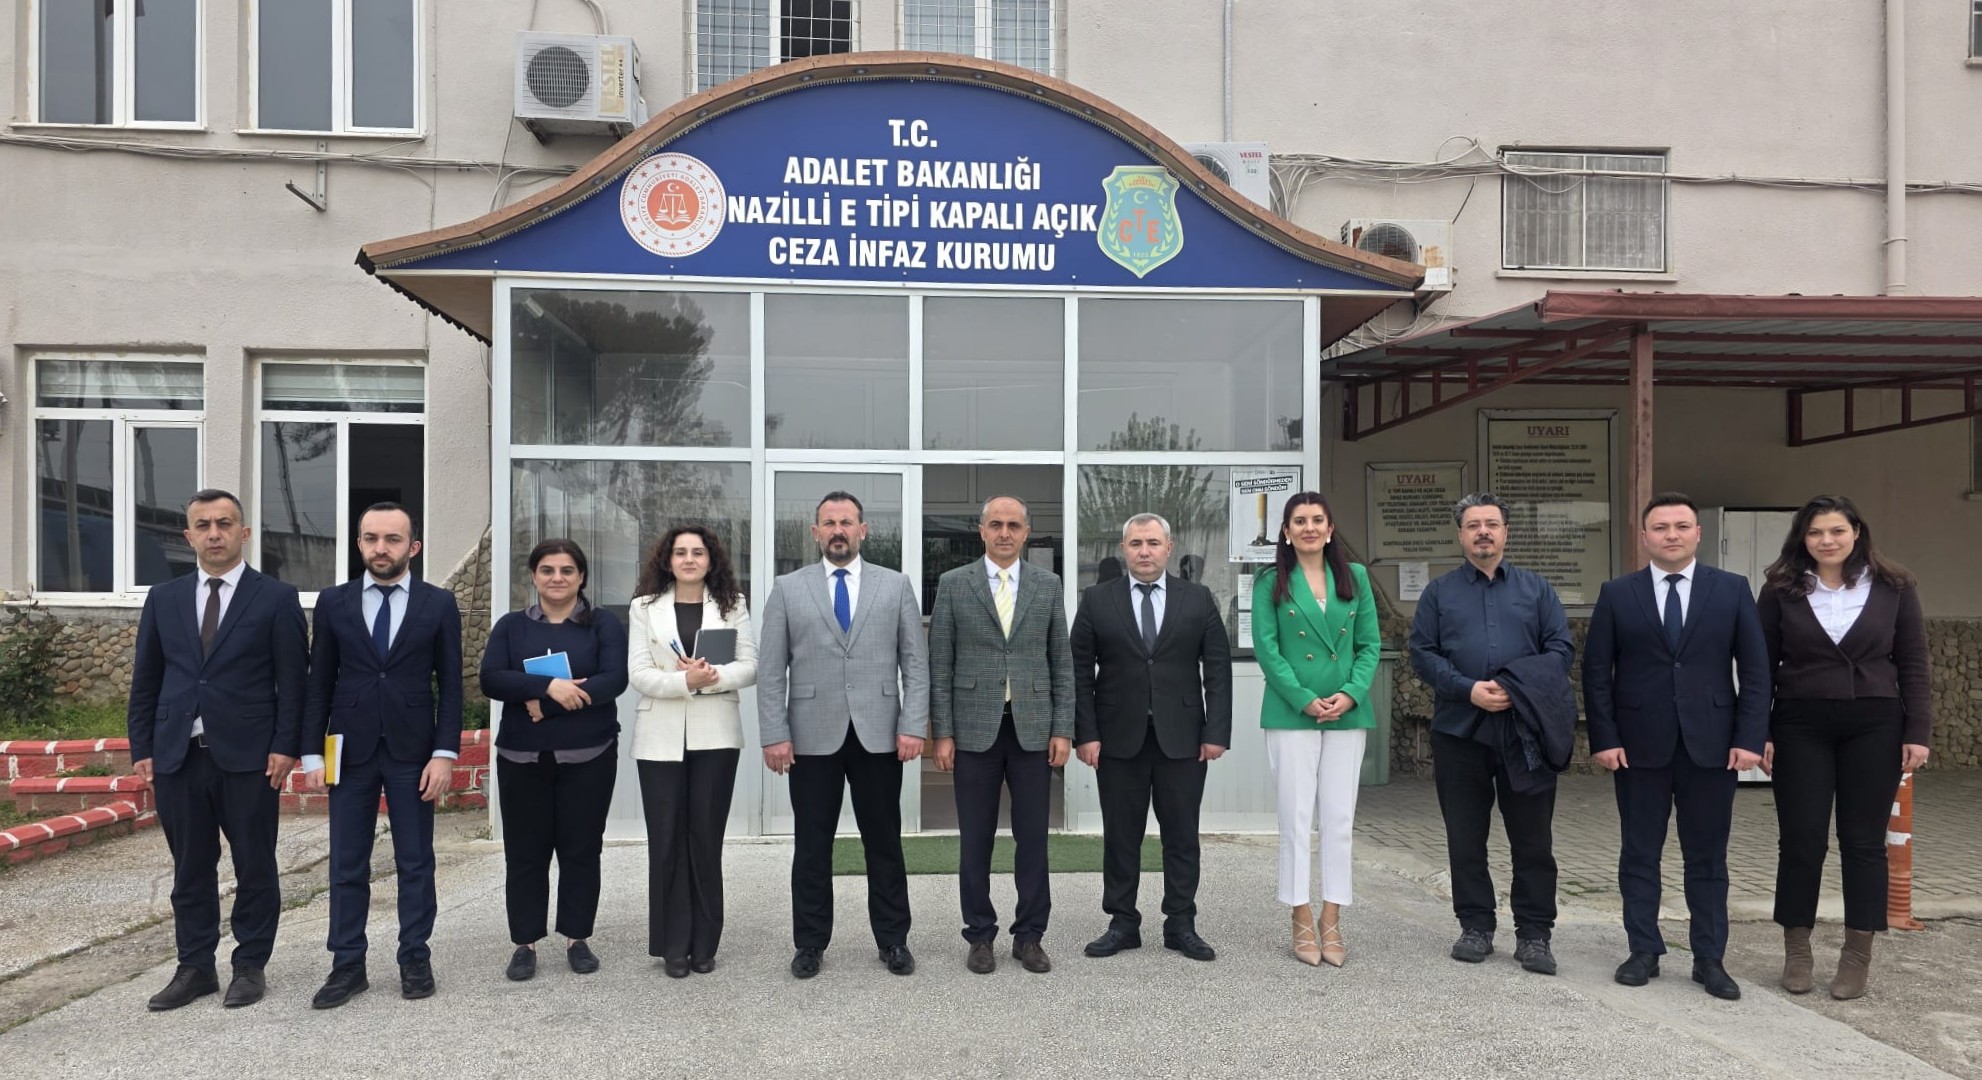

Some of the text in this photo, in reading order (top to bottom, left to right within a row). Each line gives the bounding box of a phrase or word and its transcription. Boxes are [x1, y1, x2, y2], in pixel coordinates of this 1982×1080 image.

[888, 119, 938, 148] T.C.
[783, 156, 1041, 191] ADALET BAKANLIĞI
[728, 190, 1098, 239] NAZİLLİ E TİPİ KAPALI AÇIK
[769, 232, 1055, 271] CEZA İNFAZ KURUMU
[1527, 426, 1570, 436] UYARI
[1397, 474, 1436, 484] UYARI
